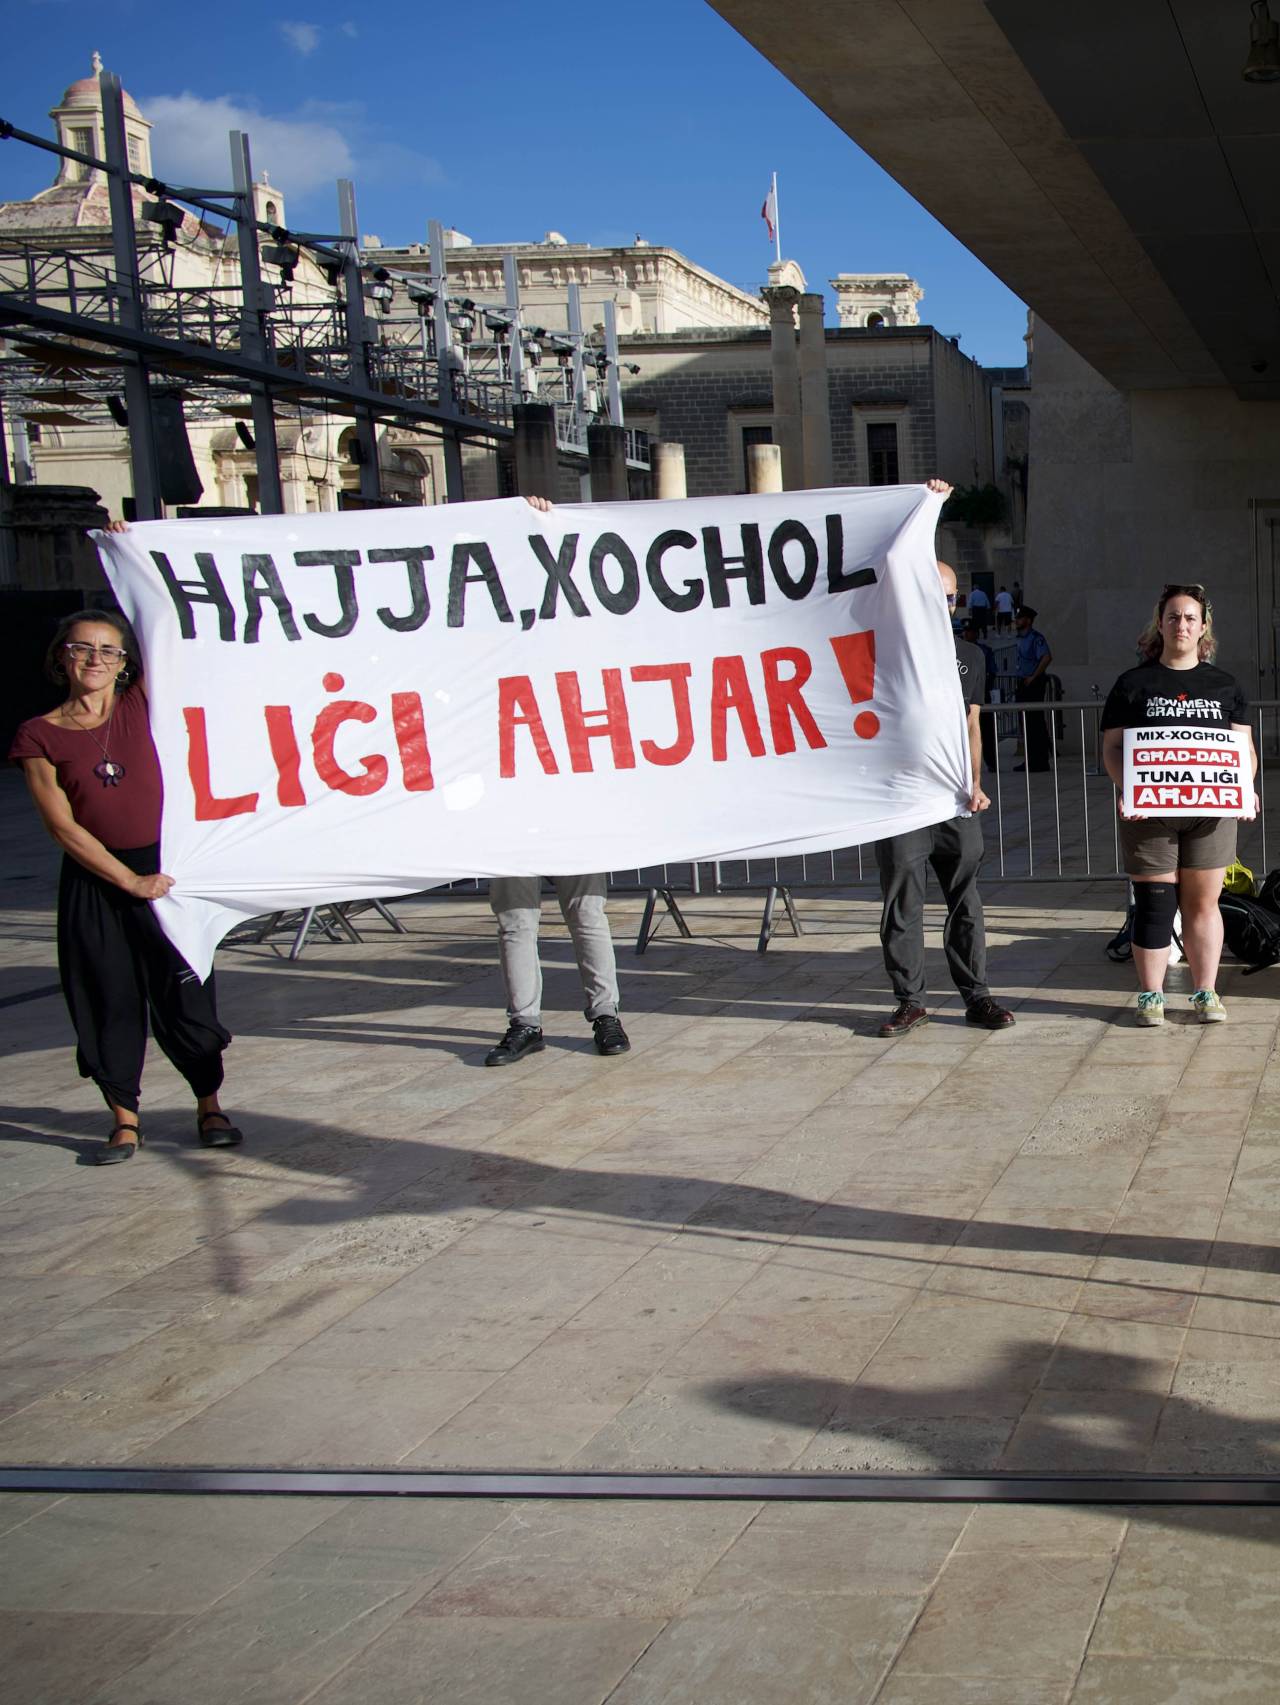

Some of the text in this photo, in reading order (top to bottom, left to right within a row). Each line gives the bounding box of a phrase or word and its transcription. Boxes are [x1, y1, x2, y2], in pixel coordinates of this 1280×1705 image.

[1146, 707, 1222, 720] GRAFFITTI
[183, 672, 434, 822] LIĠI
[1137, 769, 1239, 784] TUNA LIĠI
